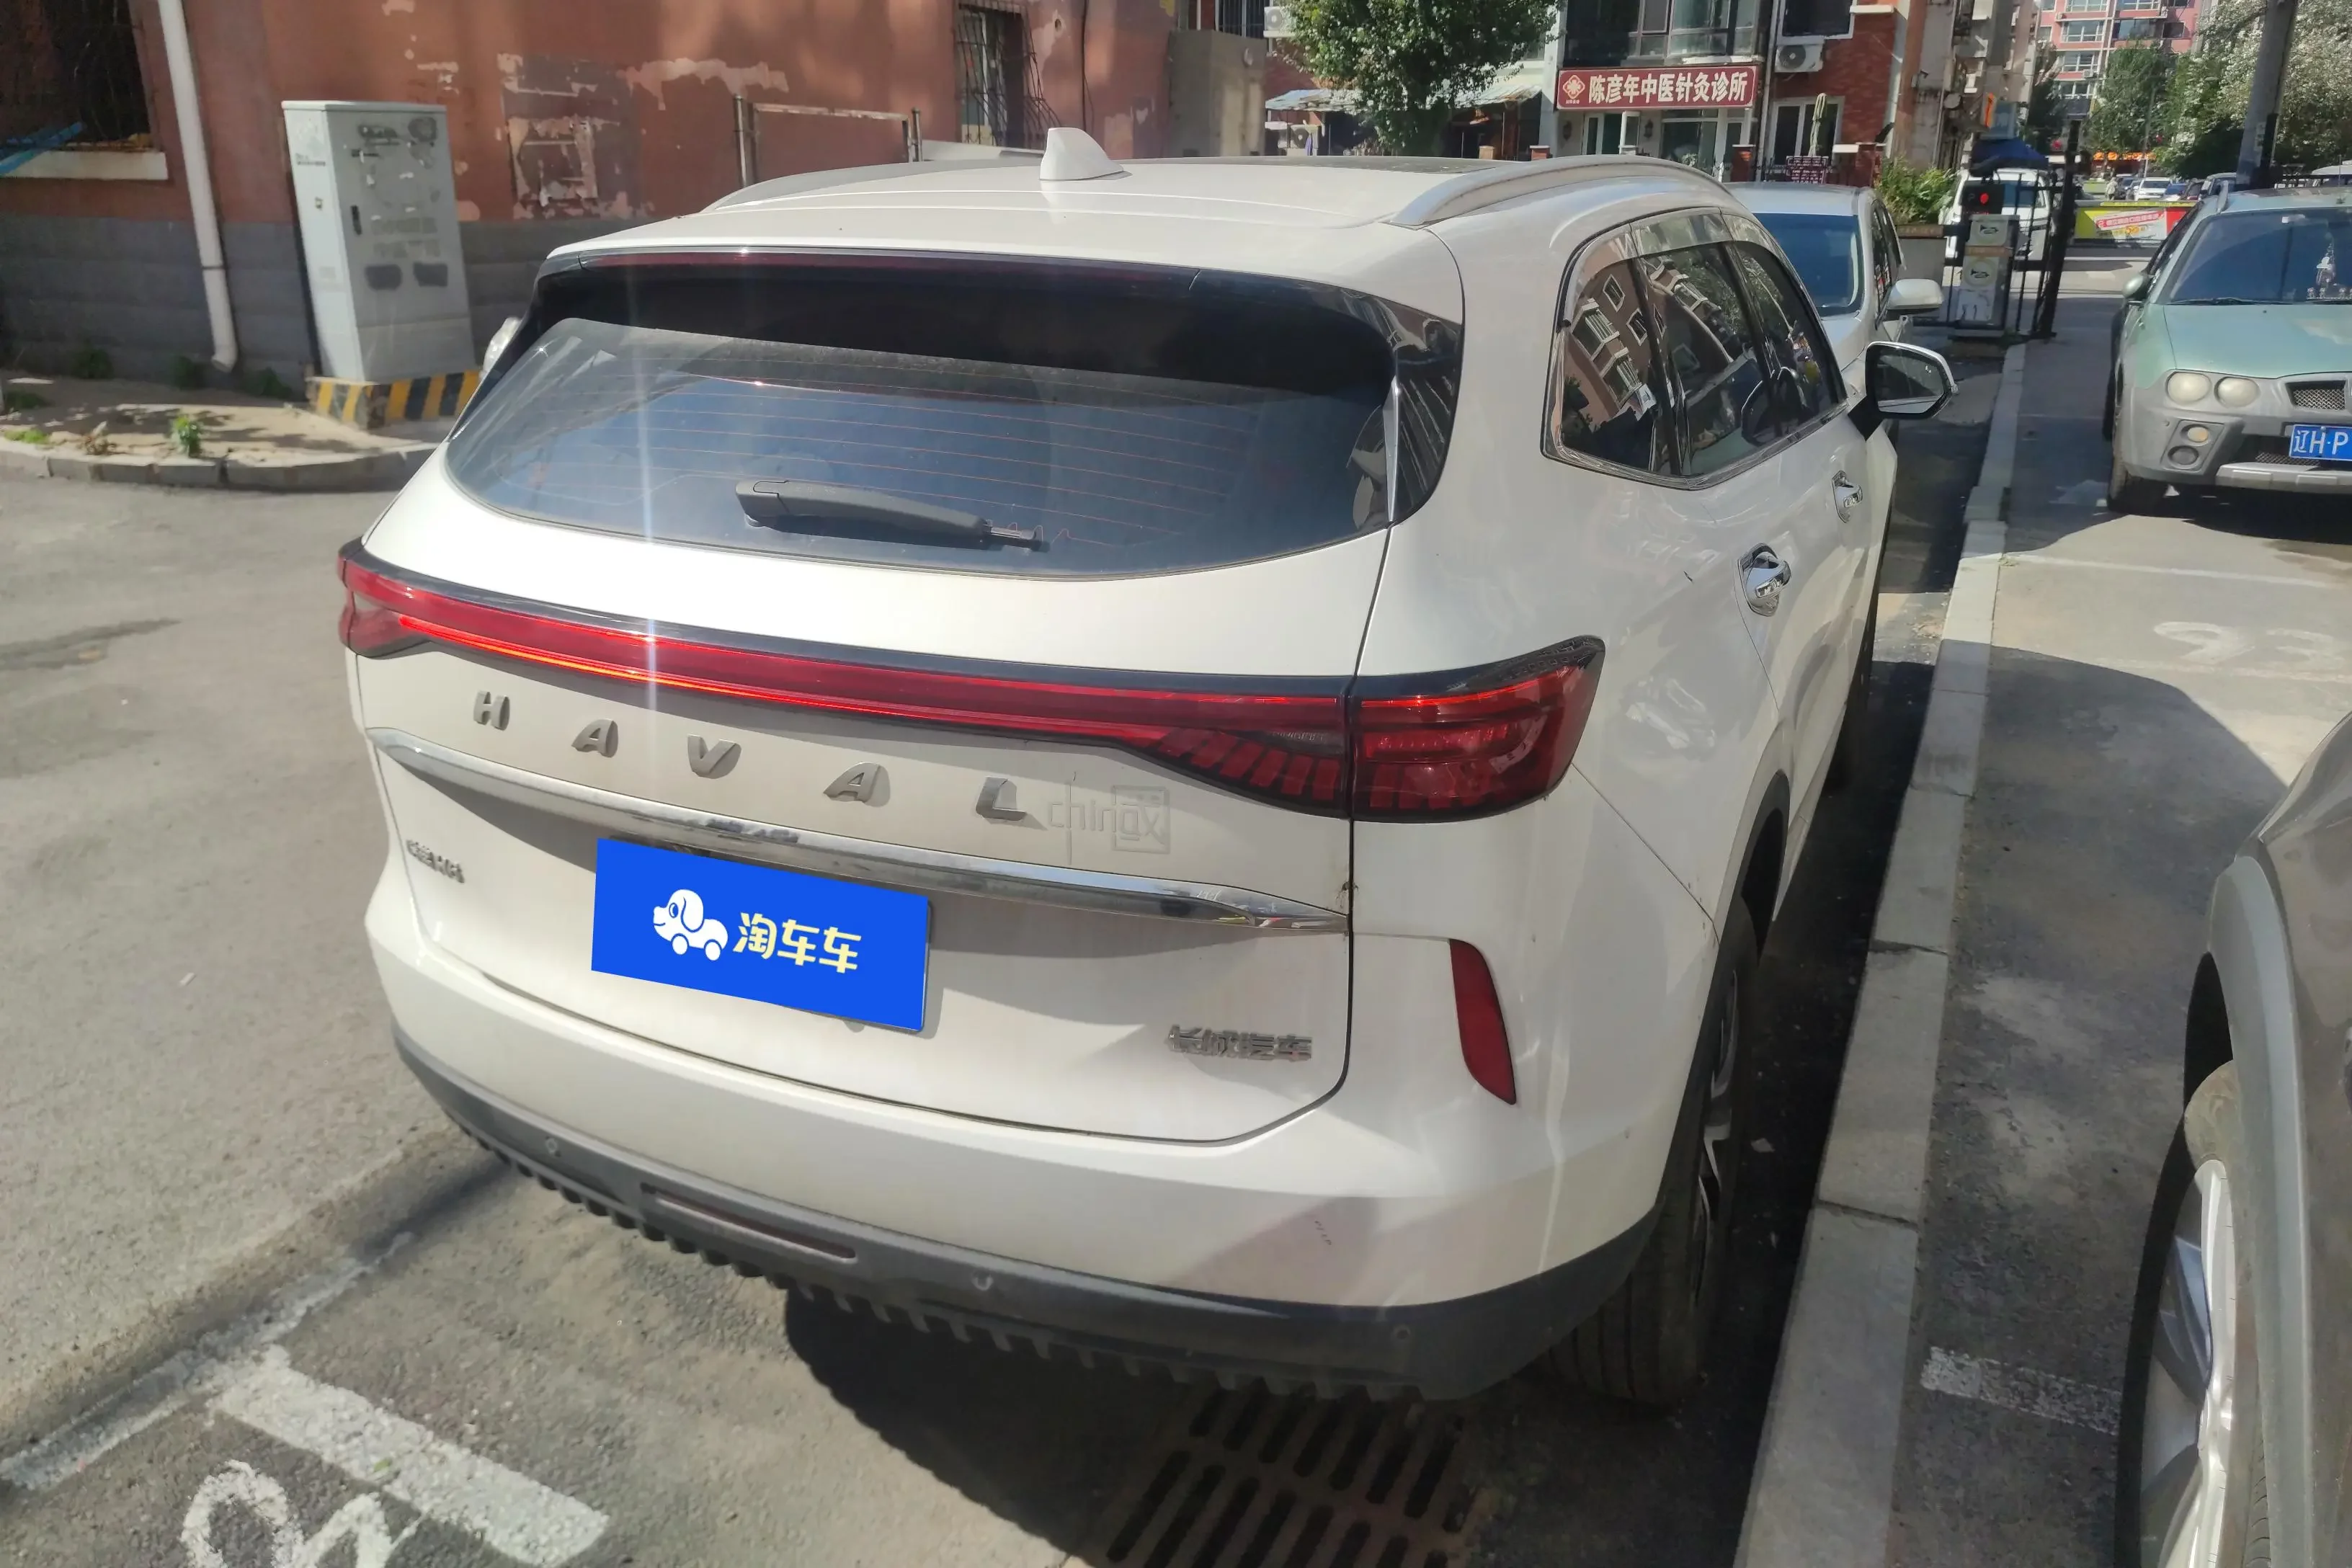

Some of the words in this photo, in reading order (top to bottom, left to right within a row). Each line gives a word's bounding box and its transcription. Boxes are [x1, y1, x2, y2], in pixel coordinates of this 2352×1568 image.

[1588, 71, 1748, 104] 陈彦年中医针灸诊所
[473, 690, 1028, 821] HAVAL
